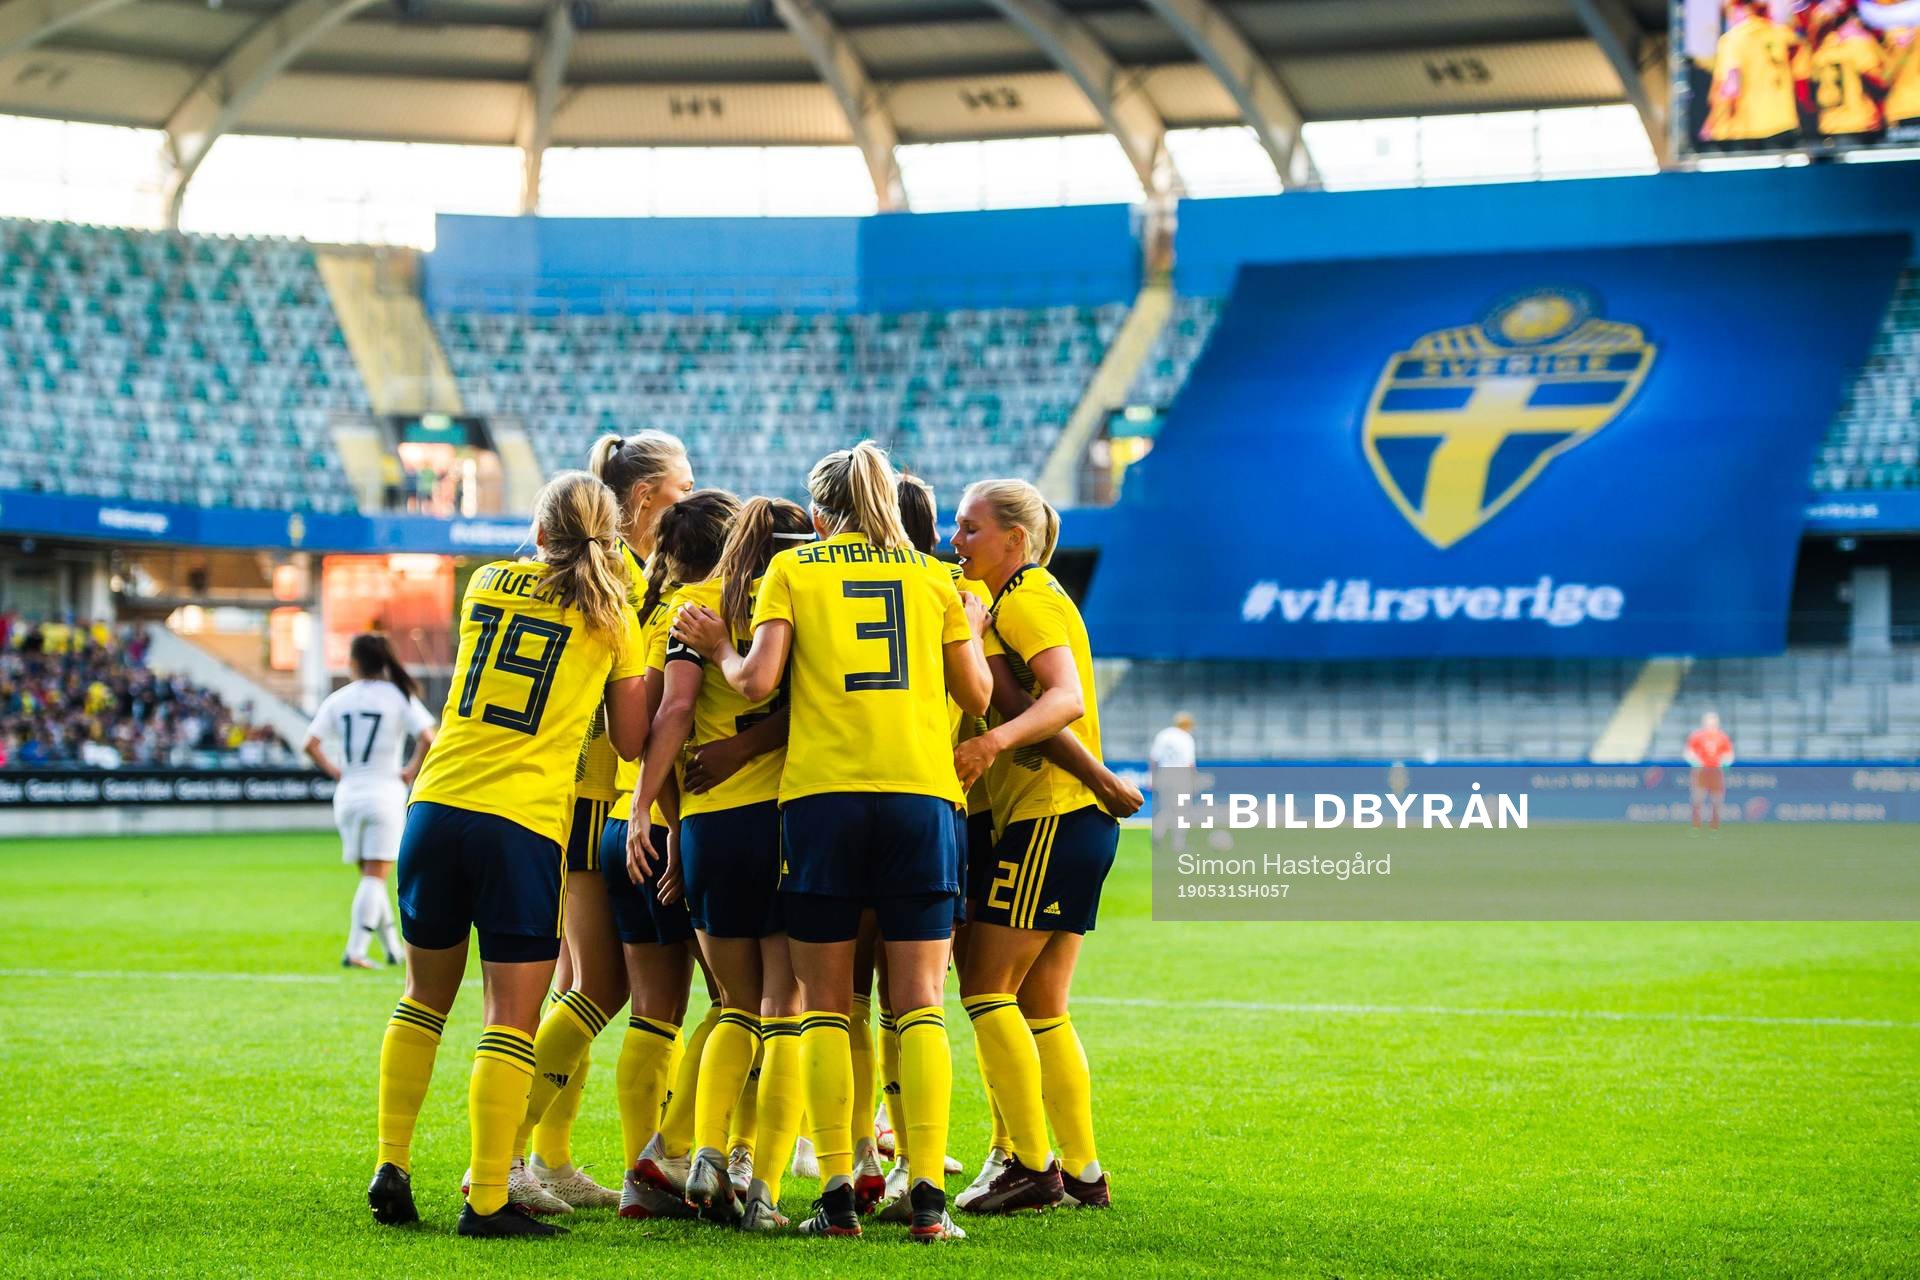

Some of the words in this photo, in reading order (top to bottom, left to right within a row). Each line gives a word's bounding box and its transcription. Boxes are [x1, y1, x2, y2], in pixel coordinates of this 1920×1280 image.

[1424, 57, 1492, 86] H3
[1423, 353, 1609, 377] SVERIGE
[1242, 576, 1624, 627] #viärsverige
[842, 580, 909, 692] 3
[458, 603, 573, 736] 19
[341, 712, 382, 763] 17
[987, 860, 1019, 910] 2
